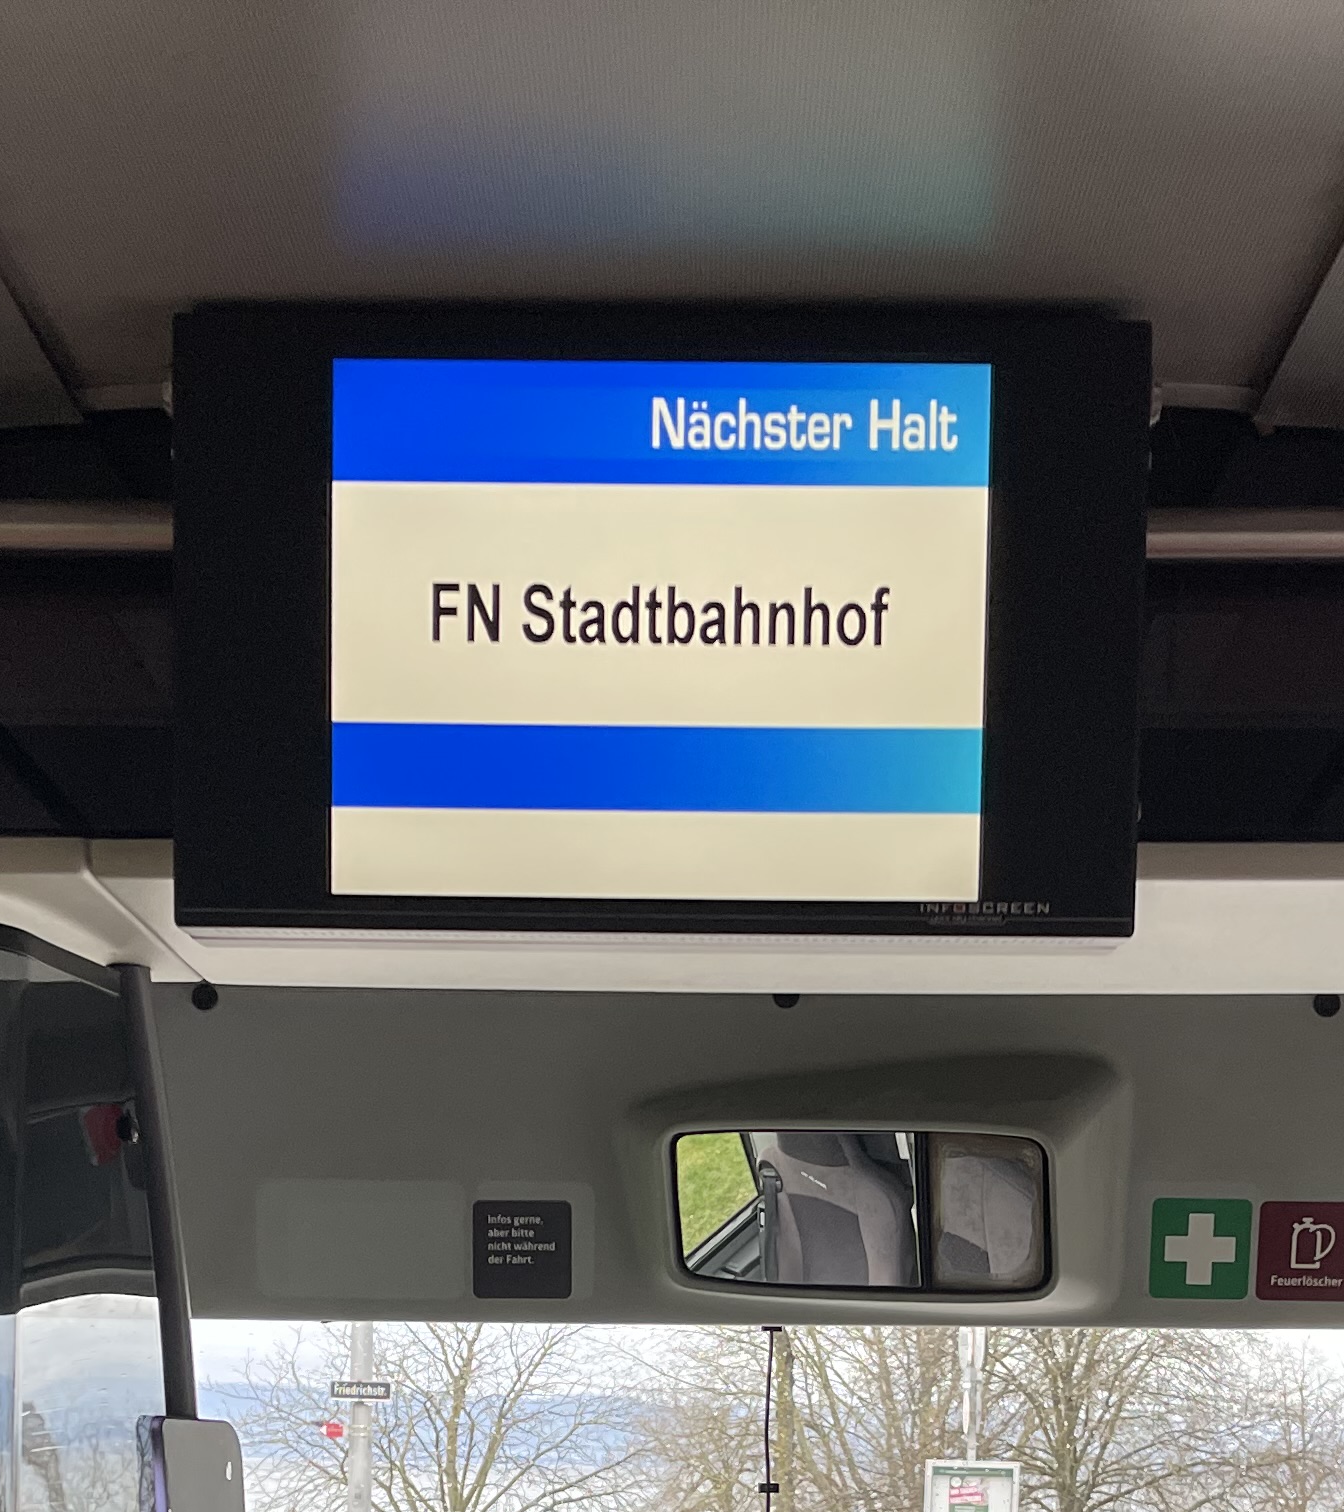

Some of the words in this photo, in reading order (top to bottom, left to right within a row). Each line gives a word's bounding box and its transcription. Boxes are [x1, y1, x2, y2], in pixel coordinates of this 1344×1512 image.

[651, 396, 853, 451] Nächster
[868, 398, 958, 452] Halt
[431, 583, 501, 643] FN
[521, 583, 890, 647] Stadtbahnhof
[487, 1214, 512, 1224] Infos
[513, 1215, 544, 1227] gerne,
[487, 1228, 510, 1238] aber
[511, 1227, 535, 1238] bitte
[487, 1241, 512, 1251] nicht
[513, 1241, 556, 1251] während
[487, 1254, 504, 1264] der
[506, 1254, 535, 1265] Fahrt.
[1270, 1274, 1344, 1287] Feuerlöscher
[333, 1381, 388, 1397] Friedrichstr.
